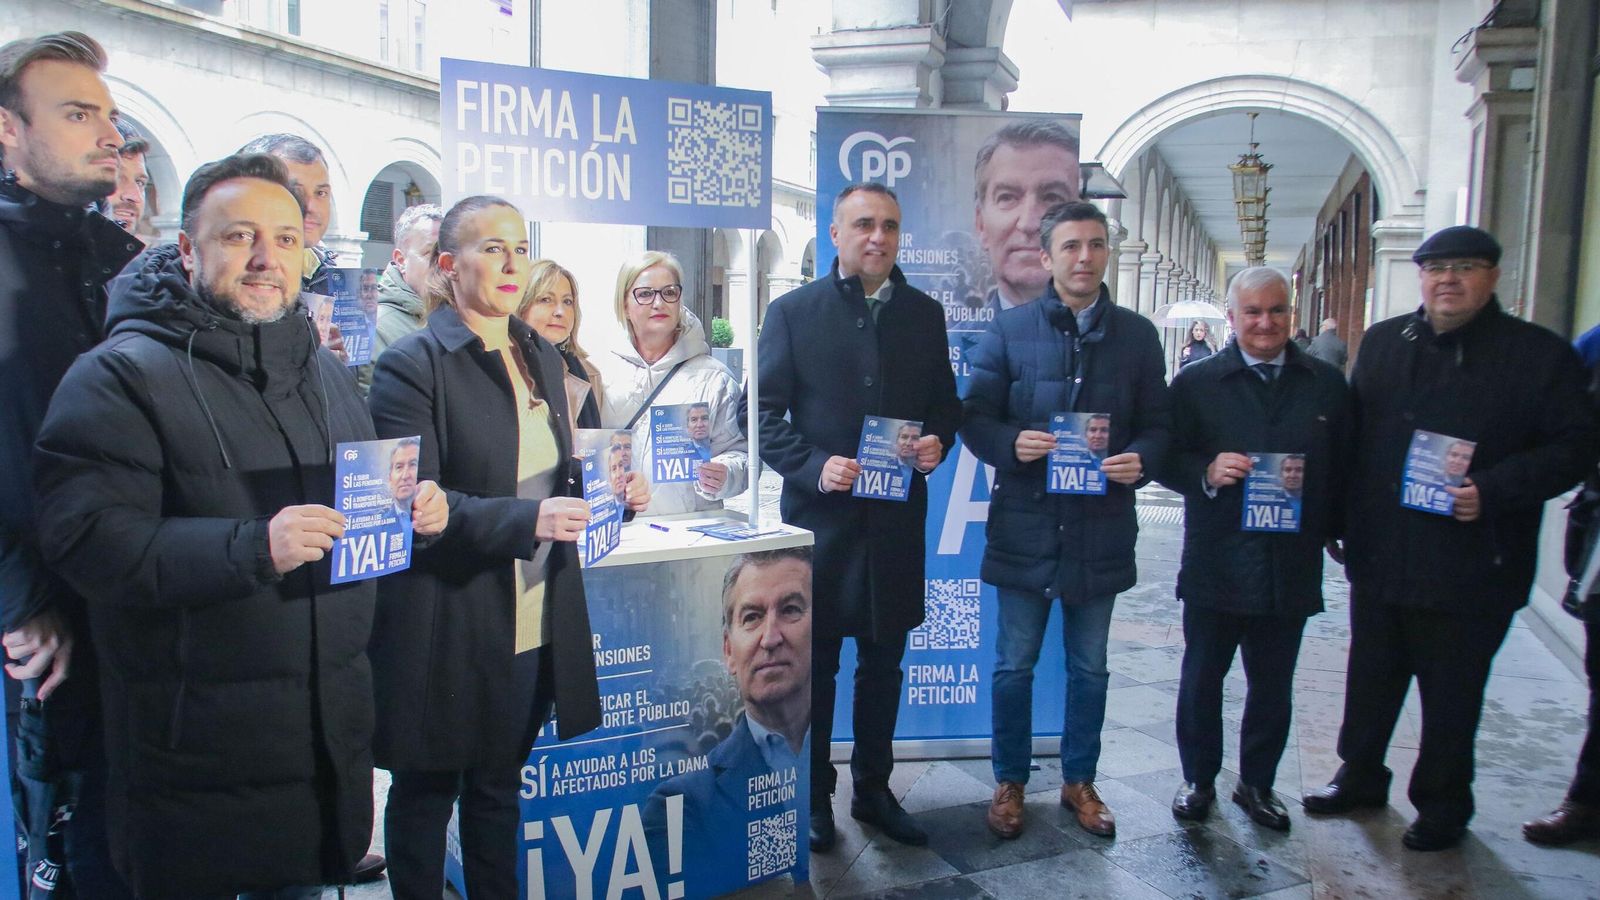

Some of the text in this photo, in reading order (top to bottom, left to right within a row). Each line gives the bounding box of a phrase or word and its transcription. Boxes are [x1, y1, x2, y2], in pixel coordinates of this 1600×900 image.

[456, 79, 638, 145] FIRMA LA
[456, 140, 631, 201] PETICIÓN
[898, 249, 959, 265] ENSIONES
[343, 472, 353, 488] SÍ
[657, 457, 690, 481] ¡YA!
[1051, 465, 1086, 491] ¡YA!
[342, 494, 352, 510] SÍ
[1246, 504, 1280, 528] ¡YA!
[338, 531, 388, 578] ¡YA!
[587, 521, 612, 563] ¡YA!
[594, 645, 651, 667] NSIONES
[909, 663, 979, 683] FIRMA LA
[636, 690, 651, 706] EL
[908, 678, 977, 704] PETICIÓN
[639, 700, 690, 723] PÚBLICO
[552, 748, 656, 779] A AYUDAR A LOS
[552, 755, 709, 797] AFECTADOS POR LA DANA
[519, 755, 549, 799] SÍ
[748, 766, 797, 793] FIRMA LA
[748, 782, 795, 811] PETICIÓN
[524, 794, 685, 900] ¡YA!
